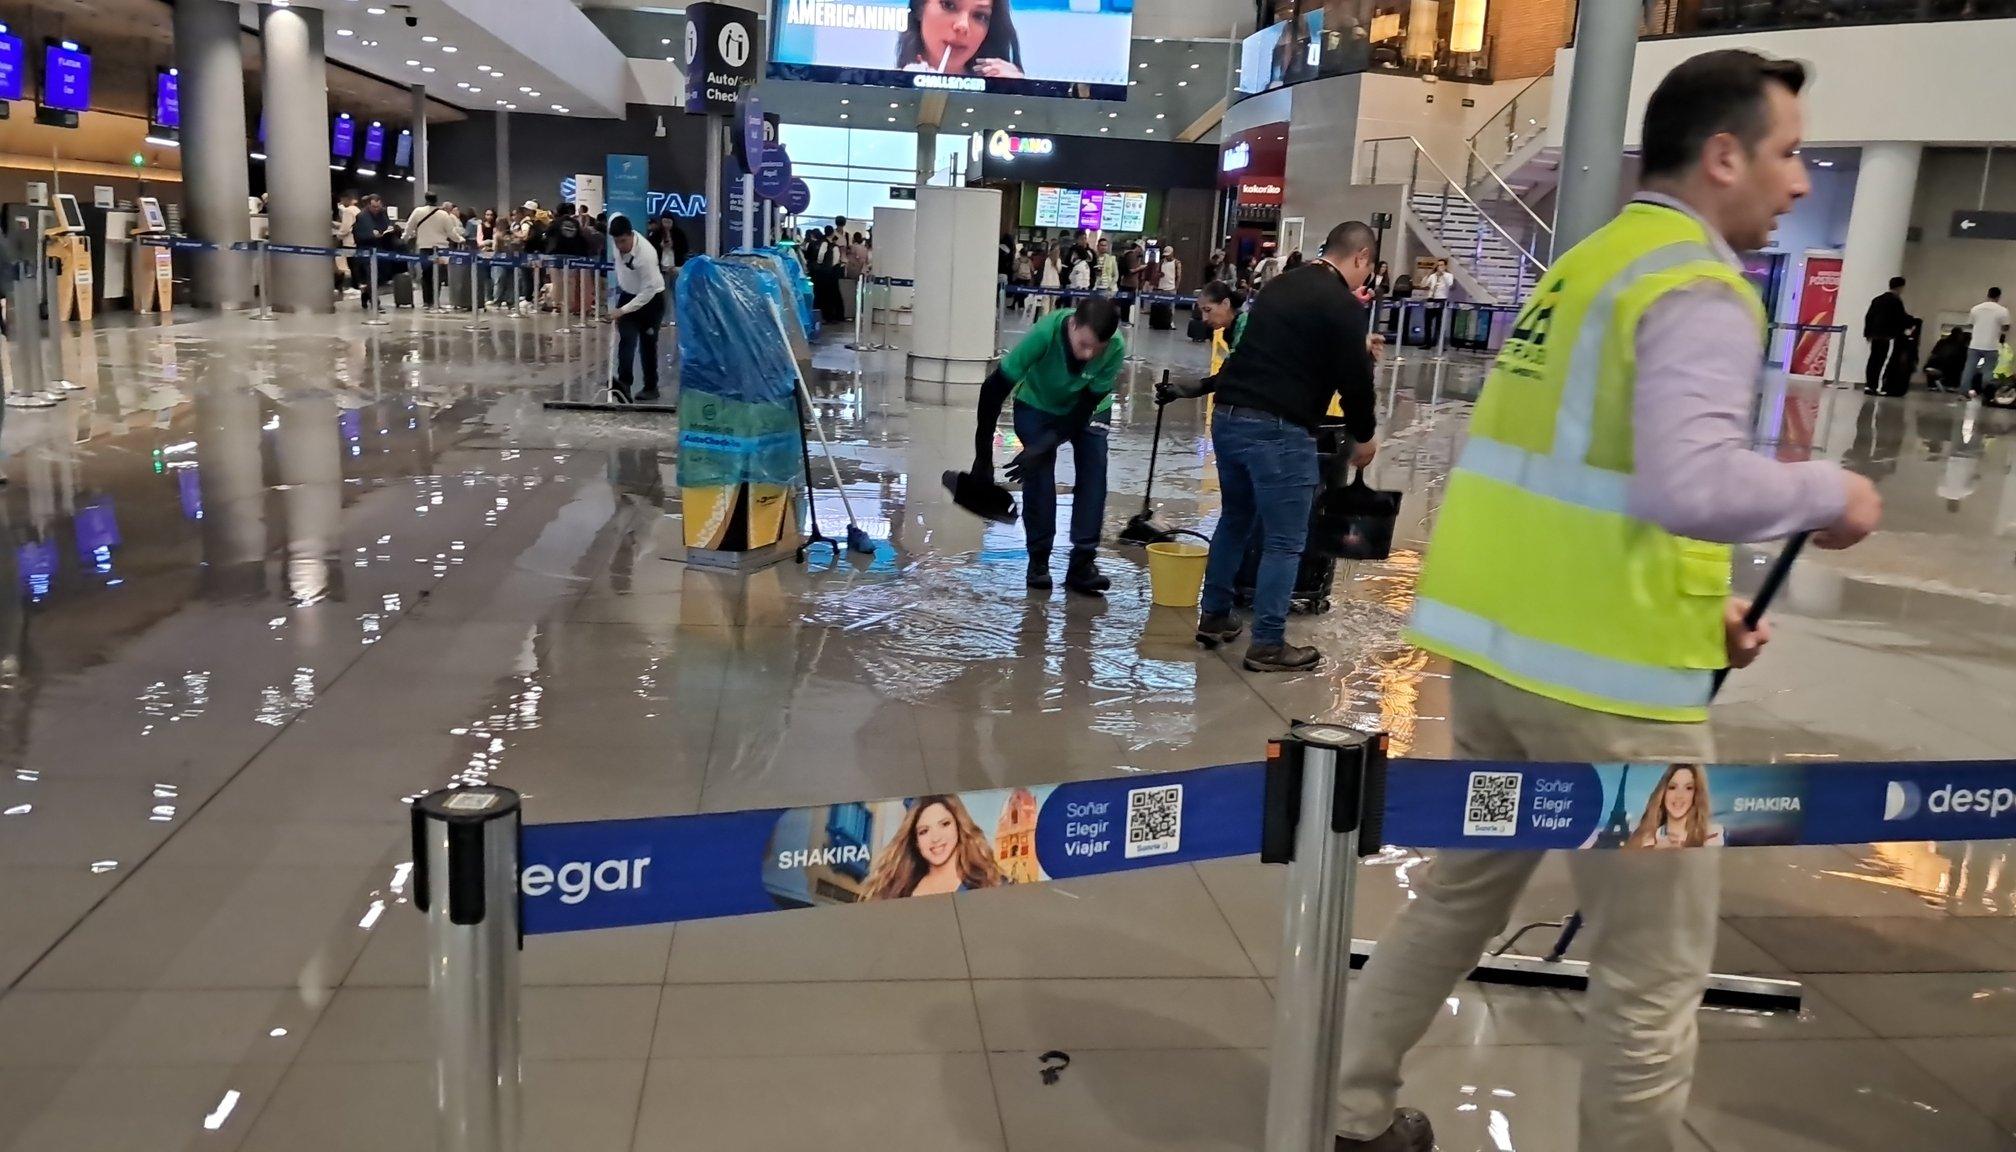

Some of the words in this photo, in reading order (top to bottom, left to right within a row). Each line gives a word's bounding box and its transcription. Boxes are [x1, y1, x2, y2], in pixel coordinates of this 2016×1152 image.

[786, 0, 909, 32] AMERICANINO
[1242, 184, 1281, 194] kokoriko
[1534, 778, 1575, 793] Soñar
[1066, 801, 1110, 818] Soñar
[1533, 796, 1573, 813] Elegir
[1732, 796, 1802, 813] SHAKIRA
[1927, 784, 2016, 818] desp
[1066, 820, 1109, 838] Elegir
[1531, 814, 1573, 830] Viajar
[778, 844, 872, 870] SHAKIRA
[1065, 839, 1111, 858] Viajar
